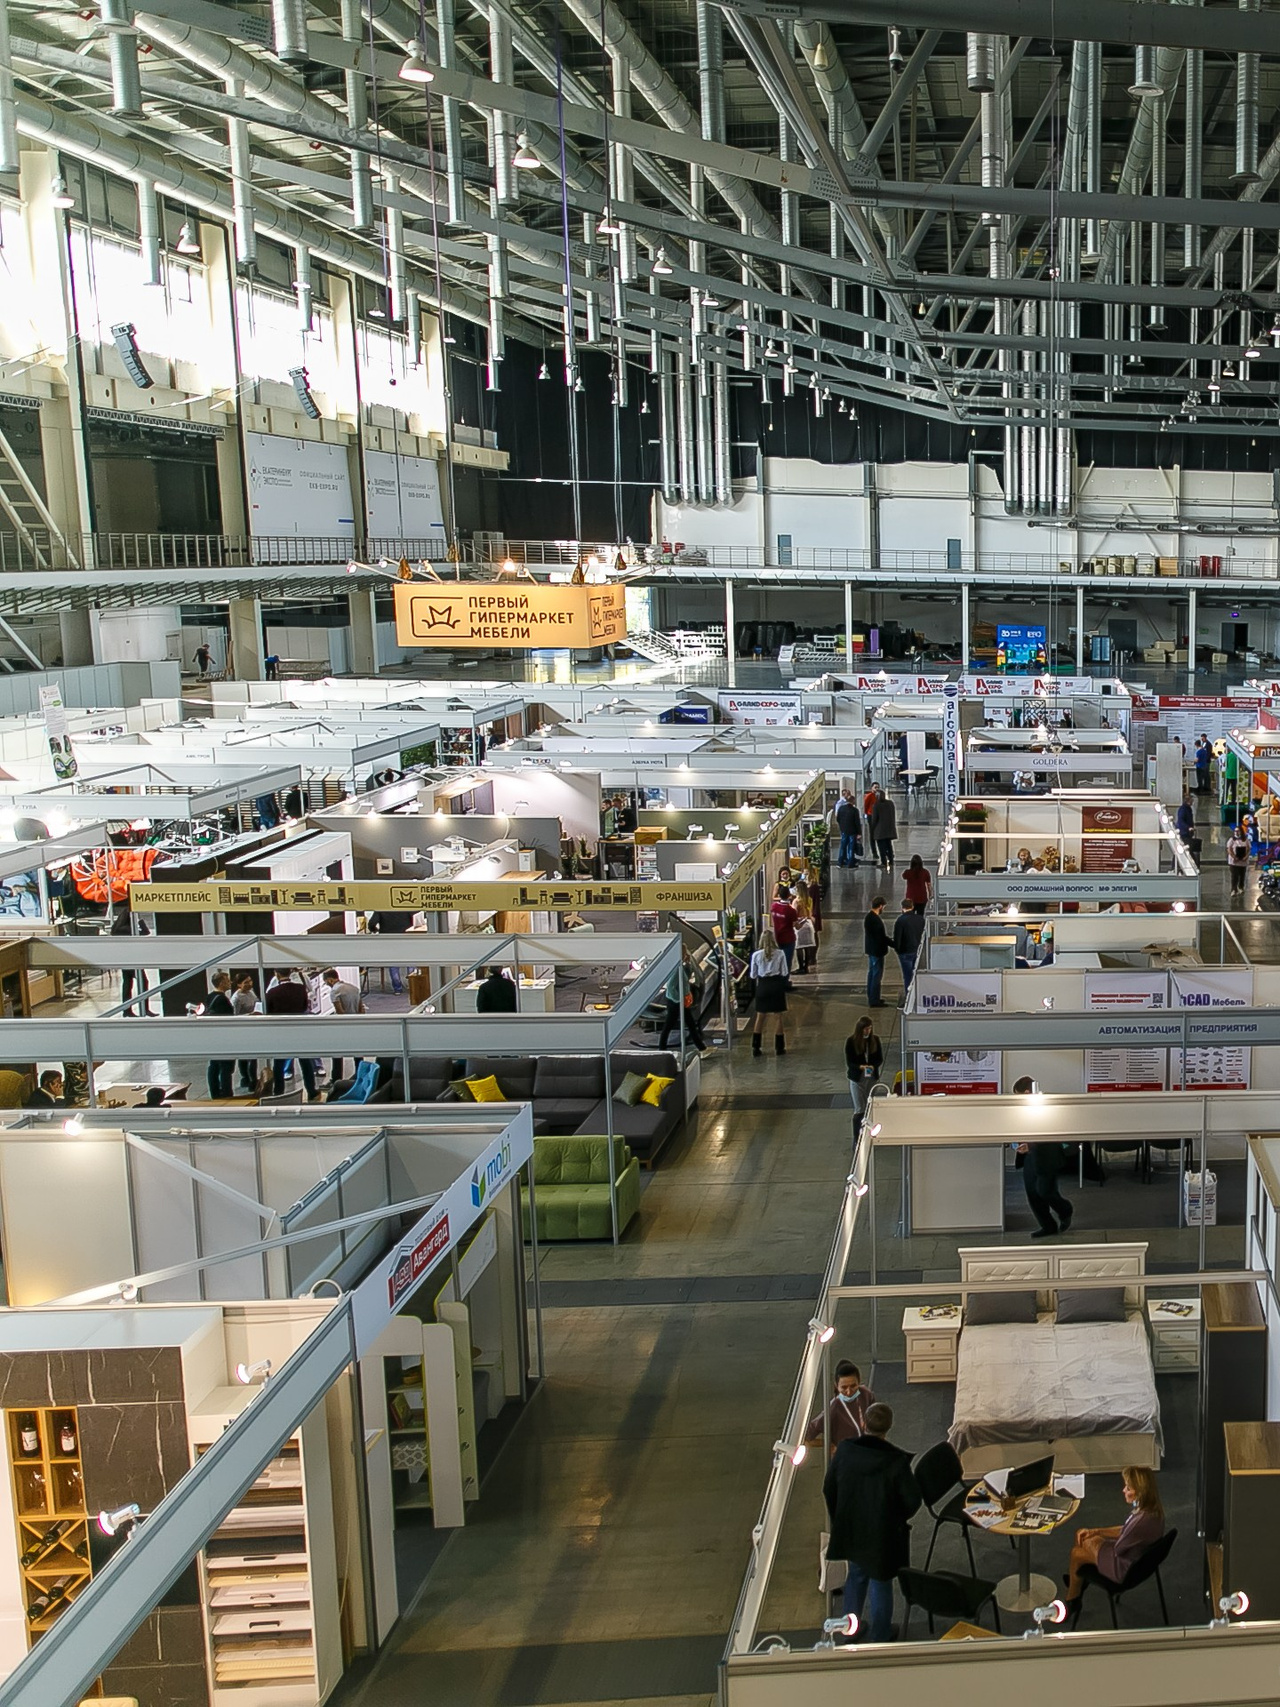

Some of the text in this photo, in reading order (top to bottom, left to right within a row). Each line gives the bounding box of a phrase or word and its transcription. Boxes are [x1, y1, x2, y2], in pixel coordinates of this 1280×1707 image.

[468, 594, 529, 608] ПЕРВЫЙ
[469, 611, 575, 624] ГИПЕРМАРКЕТ
[470, 627, 531, 639] МЕБЕЛИ
[947, 701, 956, 802] arcobaleno
[1033, 758, 1068, 766] GOLDERA
[420, 885, 453, 893] ПЕРВЫЙ
[135, 891, 212, 903] МАРКЕТПЛЕЙС
[656, 892, 713, 901] ФРАНШИЗА
[922, 995, 986, 1008] bCAD Мебель
[1098, 1024, 1257, 1035] АВТОМАТИЗАЦИЯ ПРЕДПРИЯТИЯ
[487, 1133, 512, 1186] mobi
